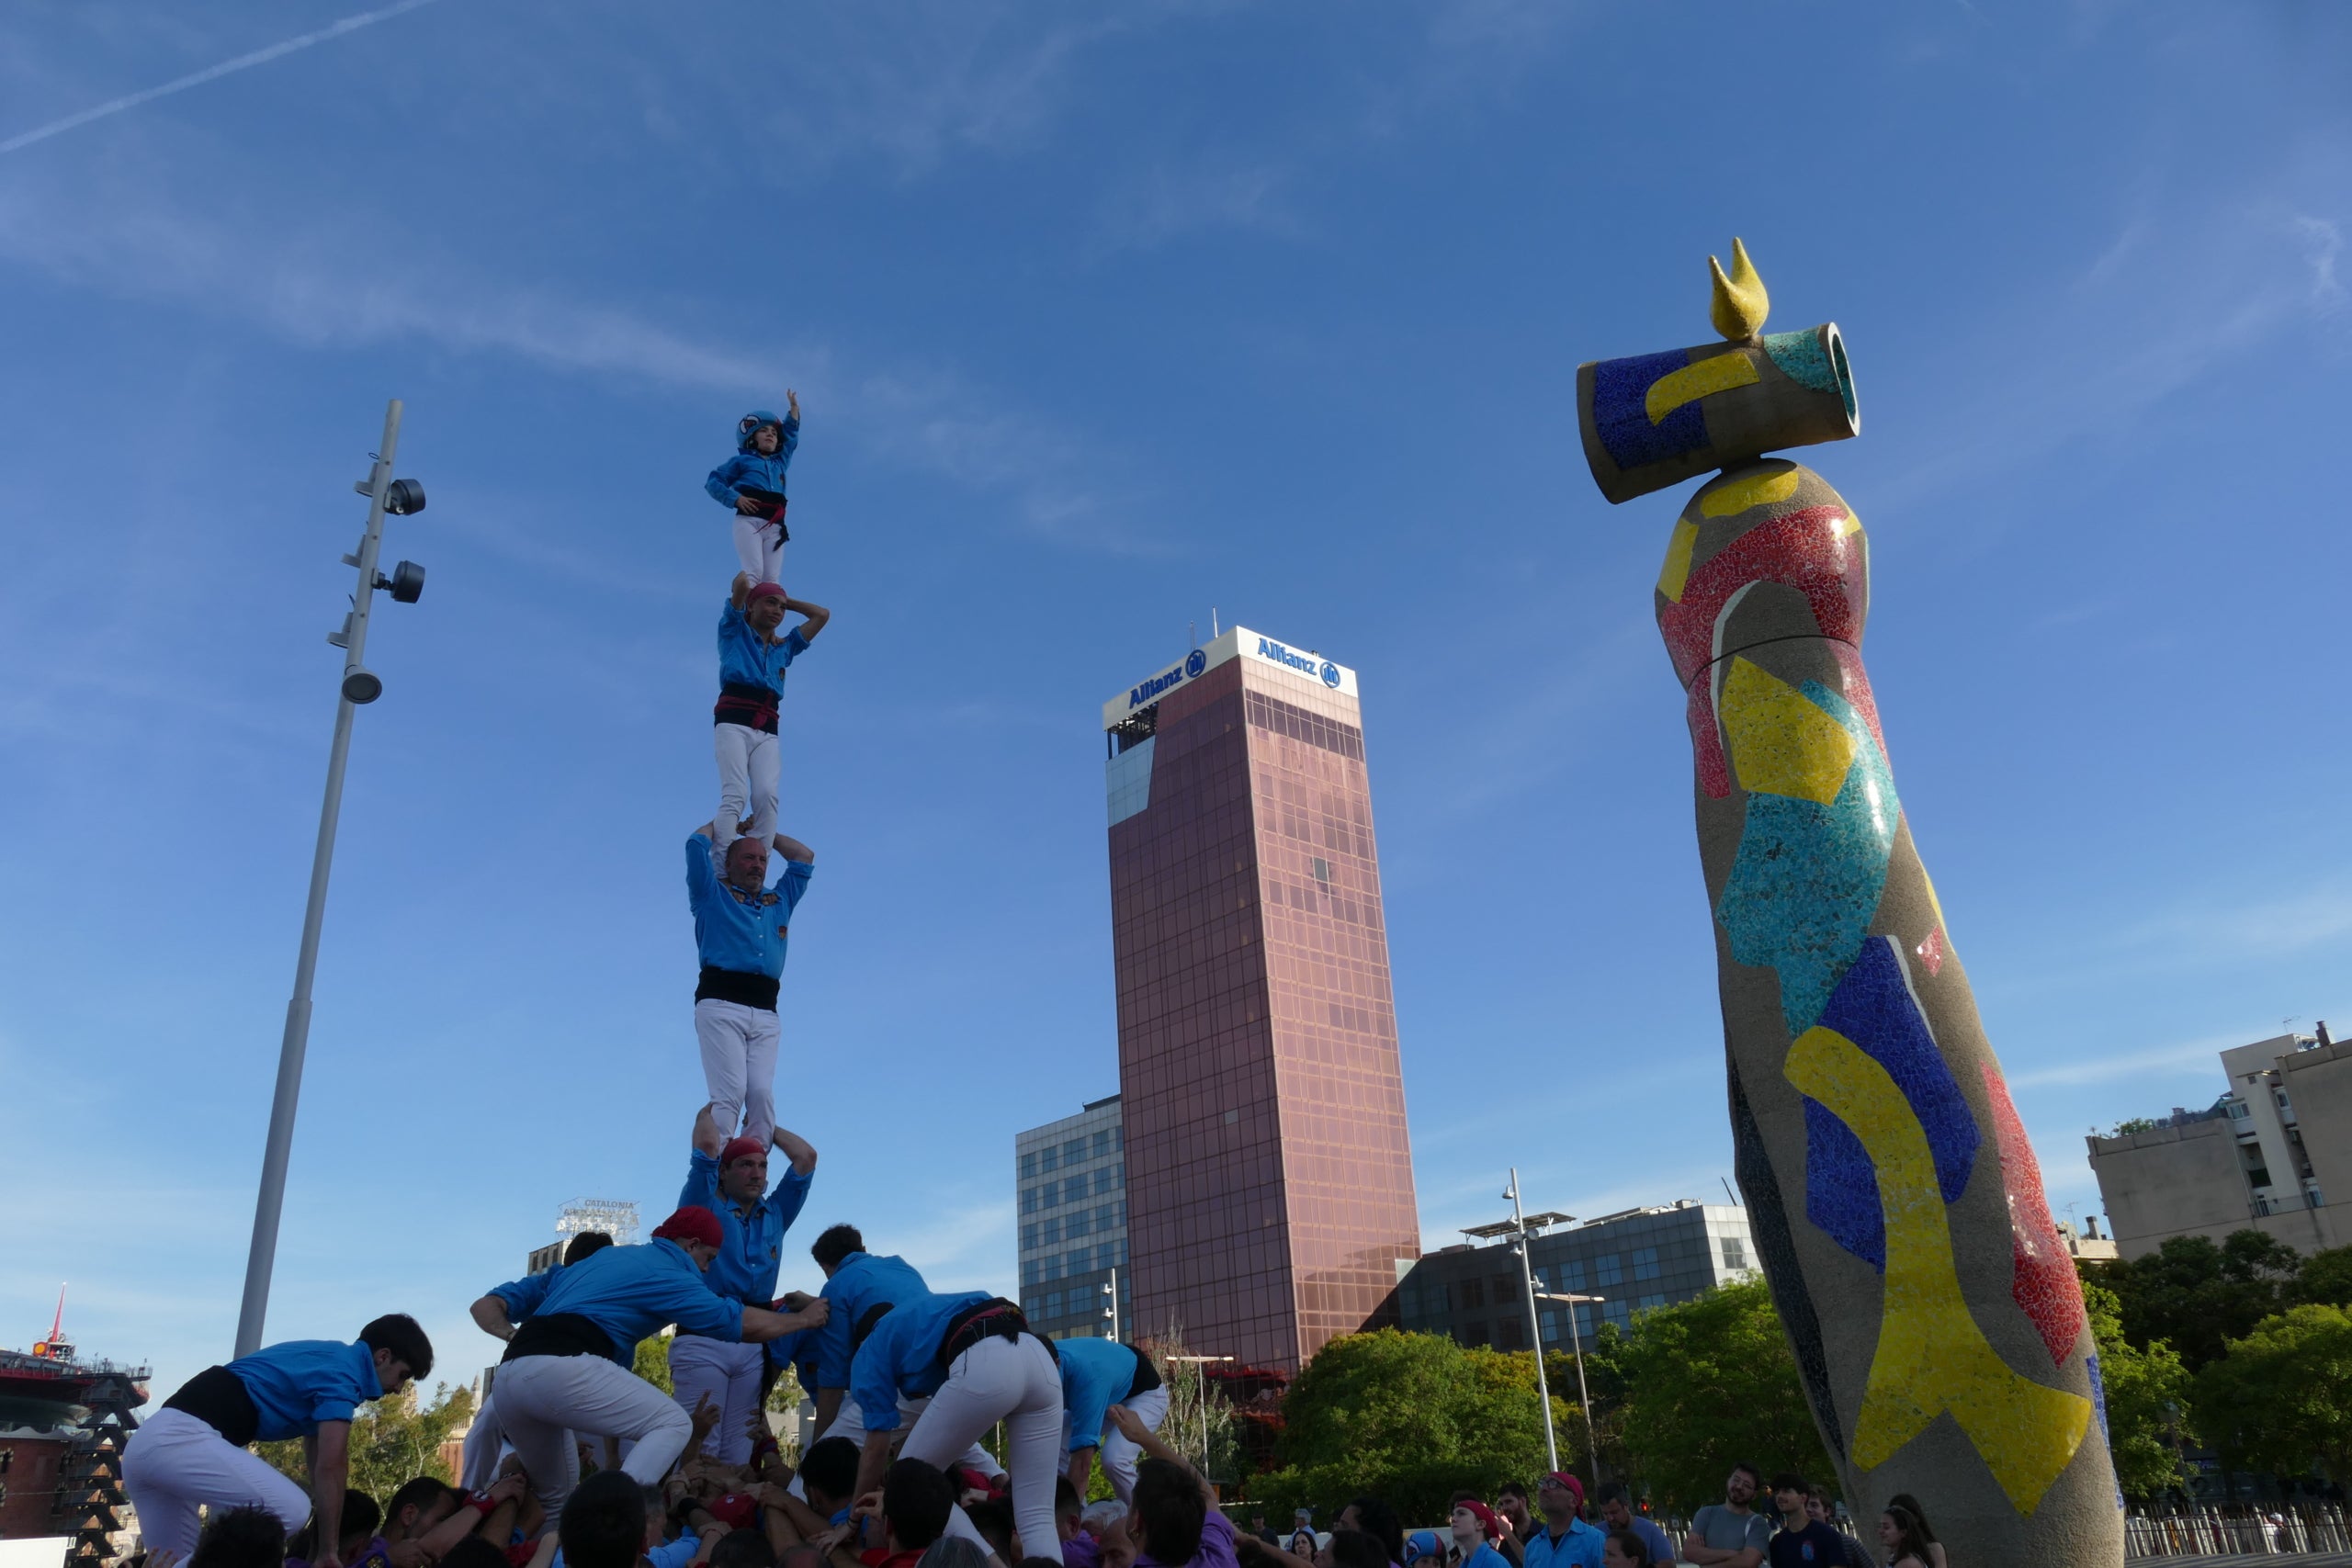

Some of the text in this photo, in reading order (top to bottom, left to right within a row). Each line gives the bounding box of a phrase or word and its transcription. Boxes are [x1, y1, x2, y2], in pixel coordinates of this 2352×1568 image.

[1257, 637, 1317, 676] Allianz
[1129, 666, 1183, 709] Allianz
[584, 1199, 634, 1210] CATALONIA
